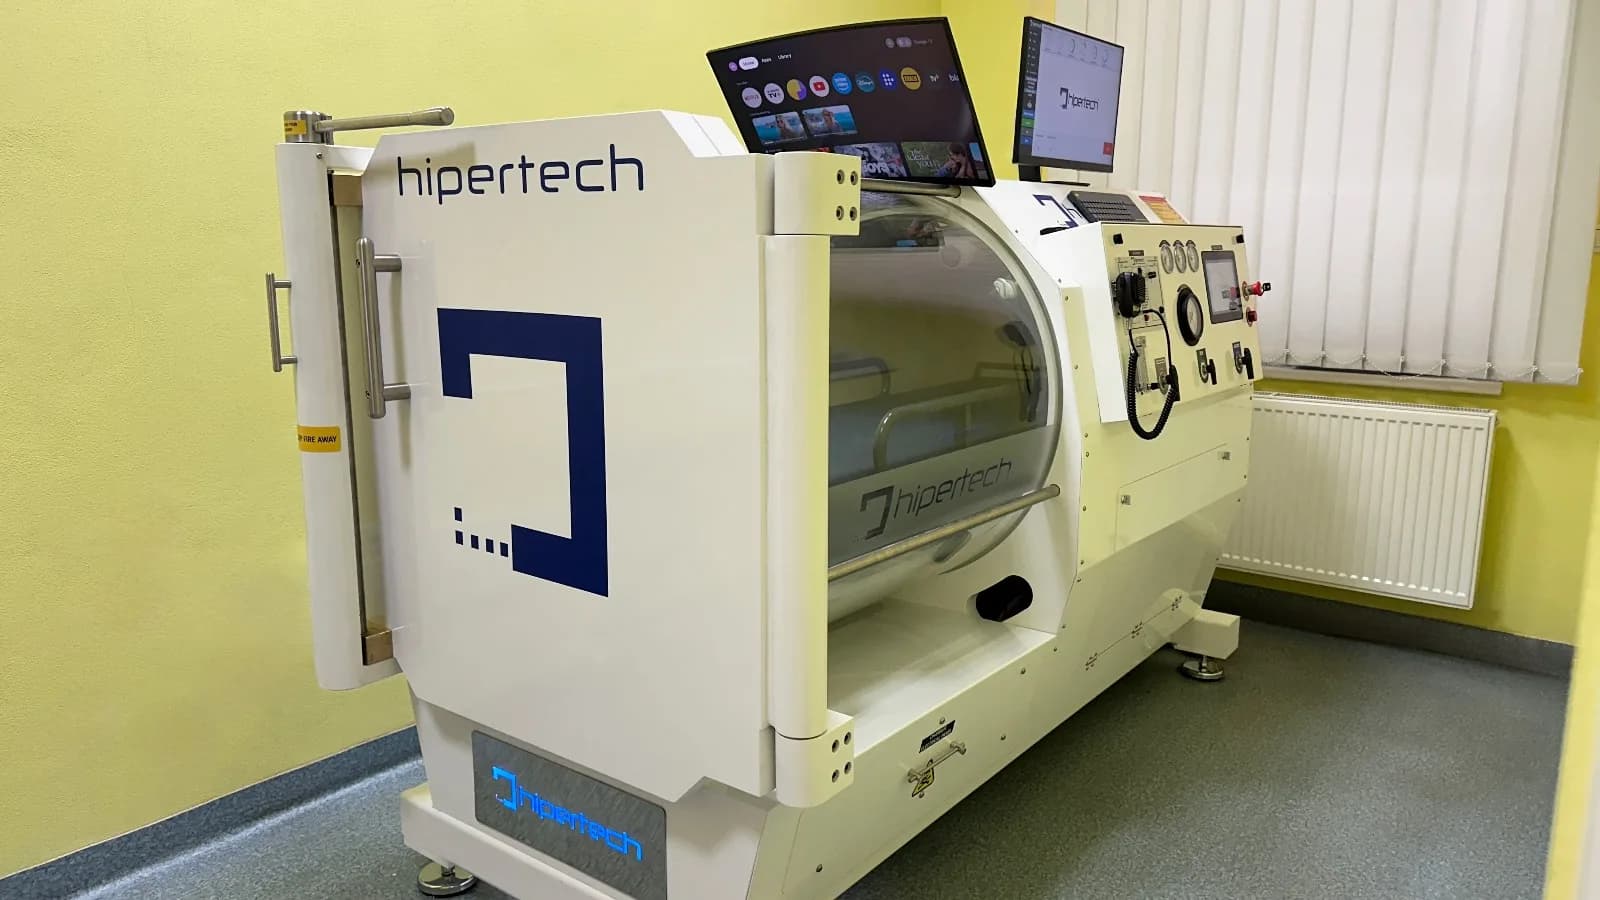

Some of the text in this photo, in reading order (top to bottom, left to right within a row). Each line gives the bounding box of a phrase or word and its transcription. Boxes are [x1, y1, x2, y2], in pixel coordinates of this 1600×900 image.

[397, 143, 643, 205] hipertech
[317, 435, 337, 443] AWAY
[893, 457, 1012, 520] hipertech
[518, 785, 643, 862] hipertech
